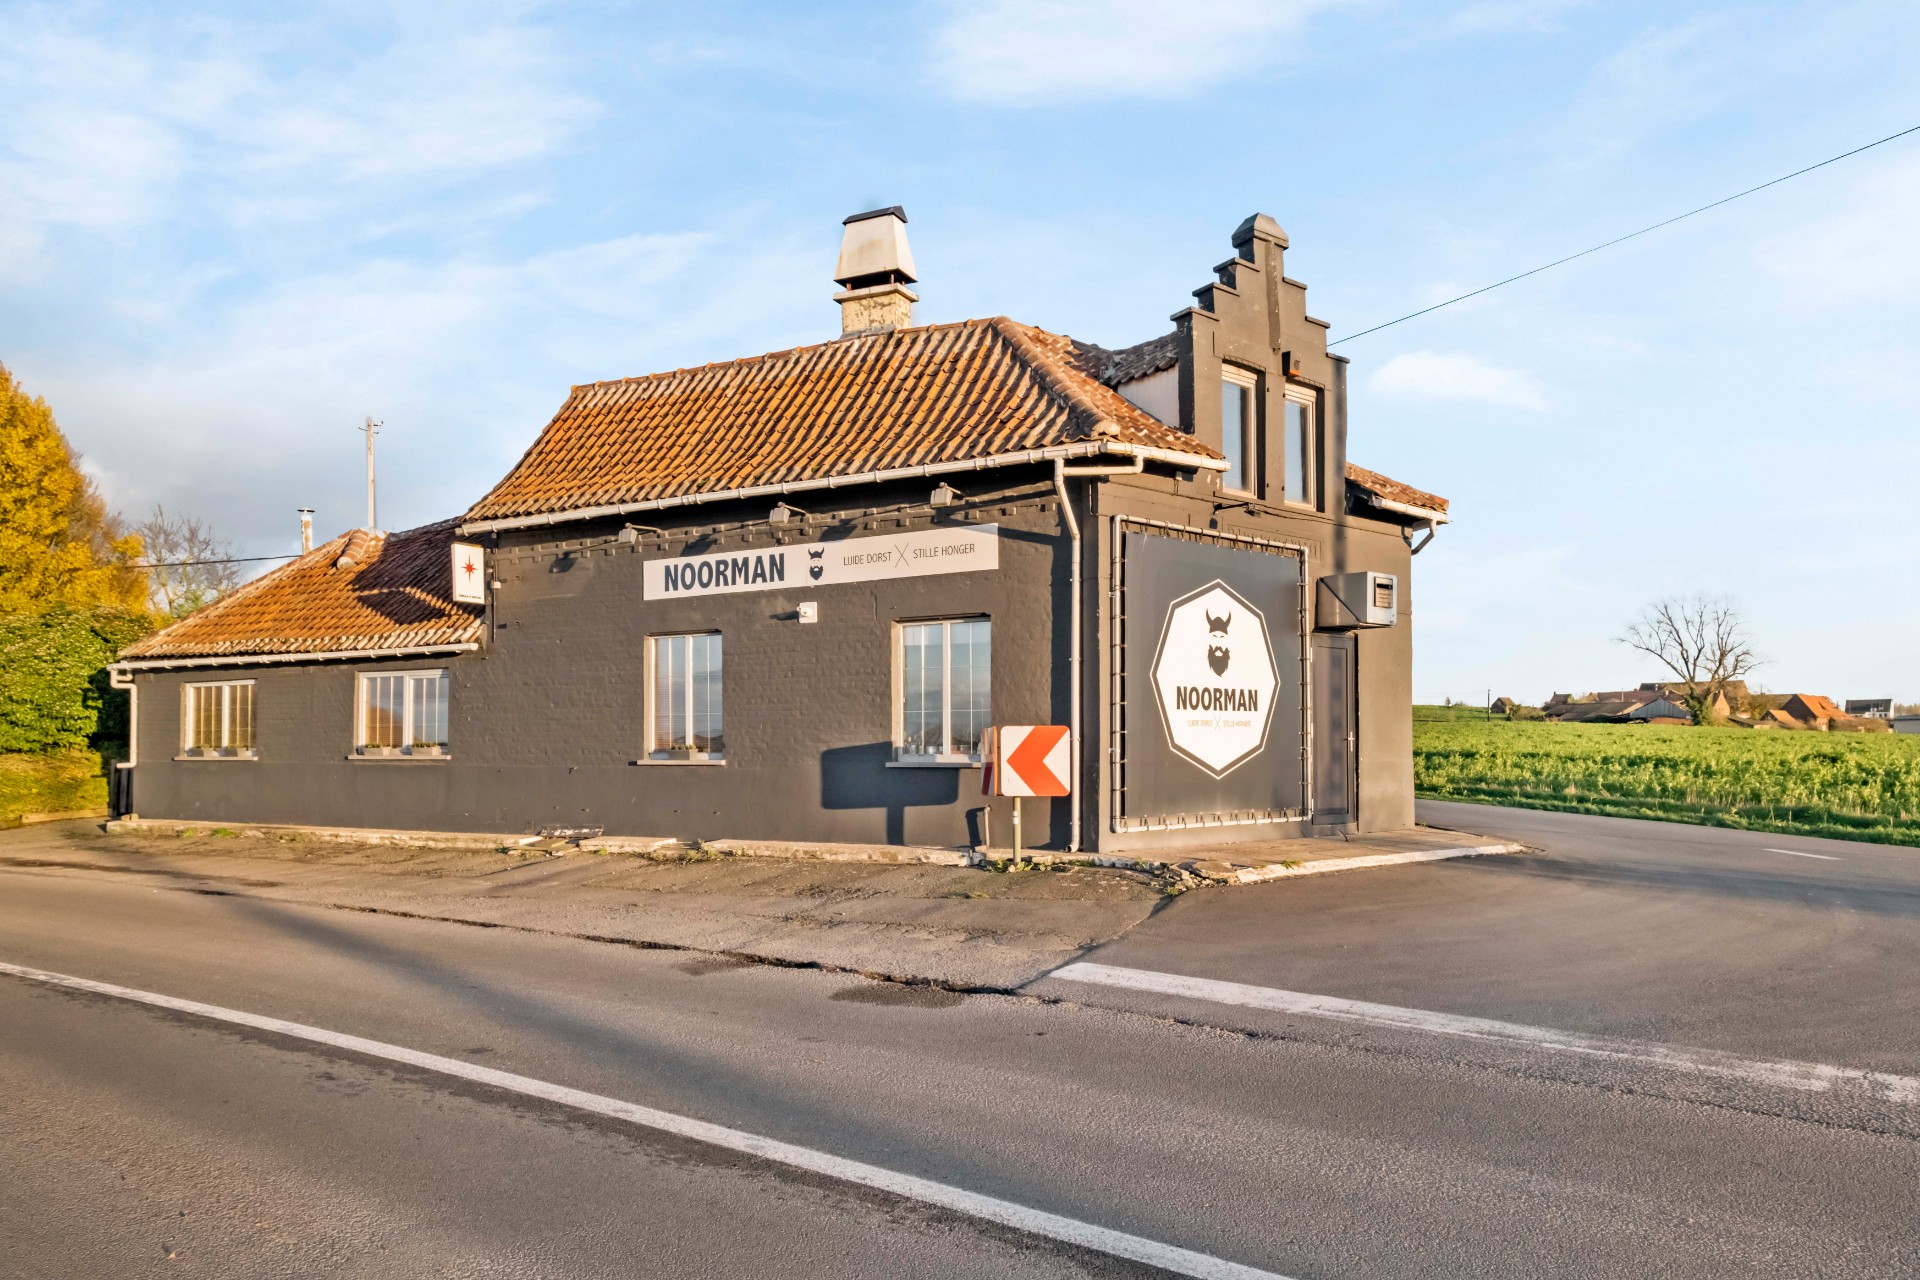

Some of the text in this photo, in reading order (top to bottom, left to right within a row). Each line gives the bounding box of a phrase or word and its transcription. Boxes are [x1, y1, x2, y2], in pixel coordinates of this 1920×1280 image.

[843, 554, 865, 566] LUIDE
[866, 551, 892, 564] DORST
[913, 547, 939, 559] STILLE
[941, 543, 975, 556] HONGER
[664, 552, 785, 592] NOORMAN
[1176, 686, 1258, 712] NOORMAN
